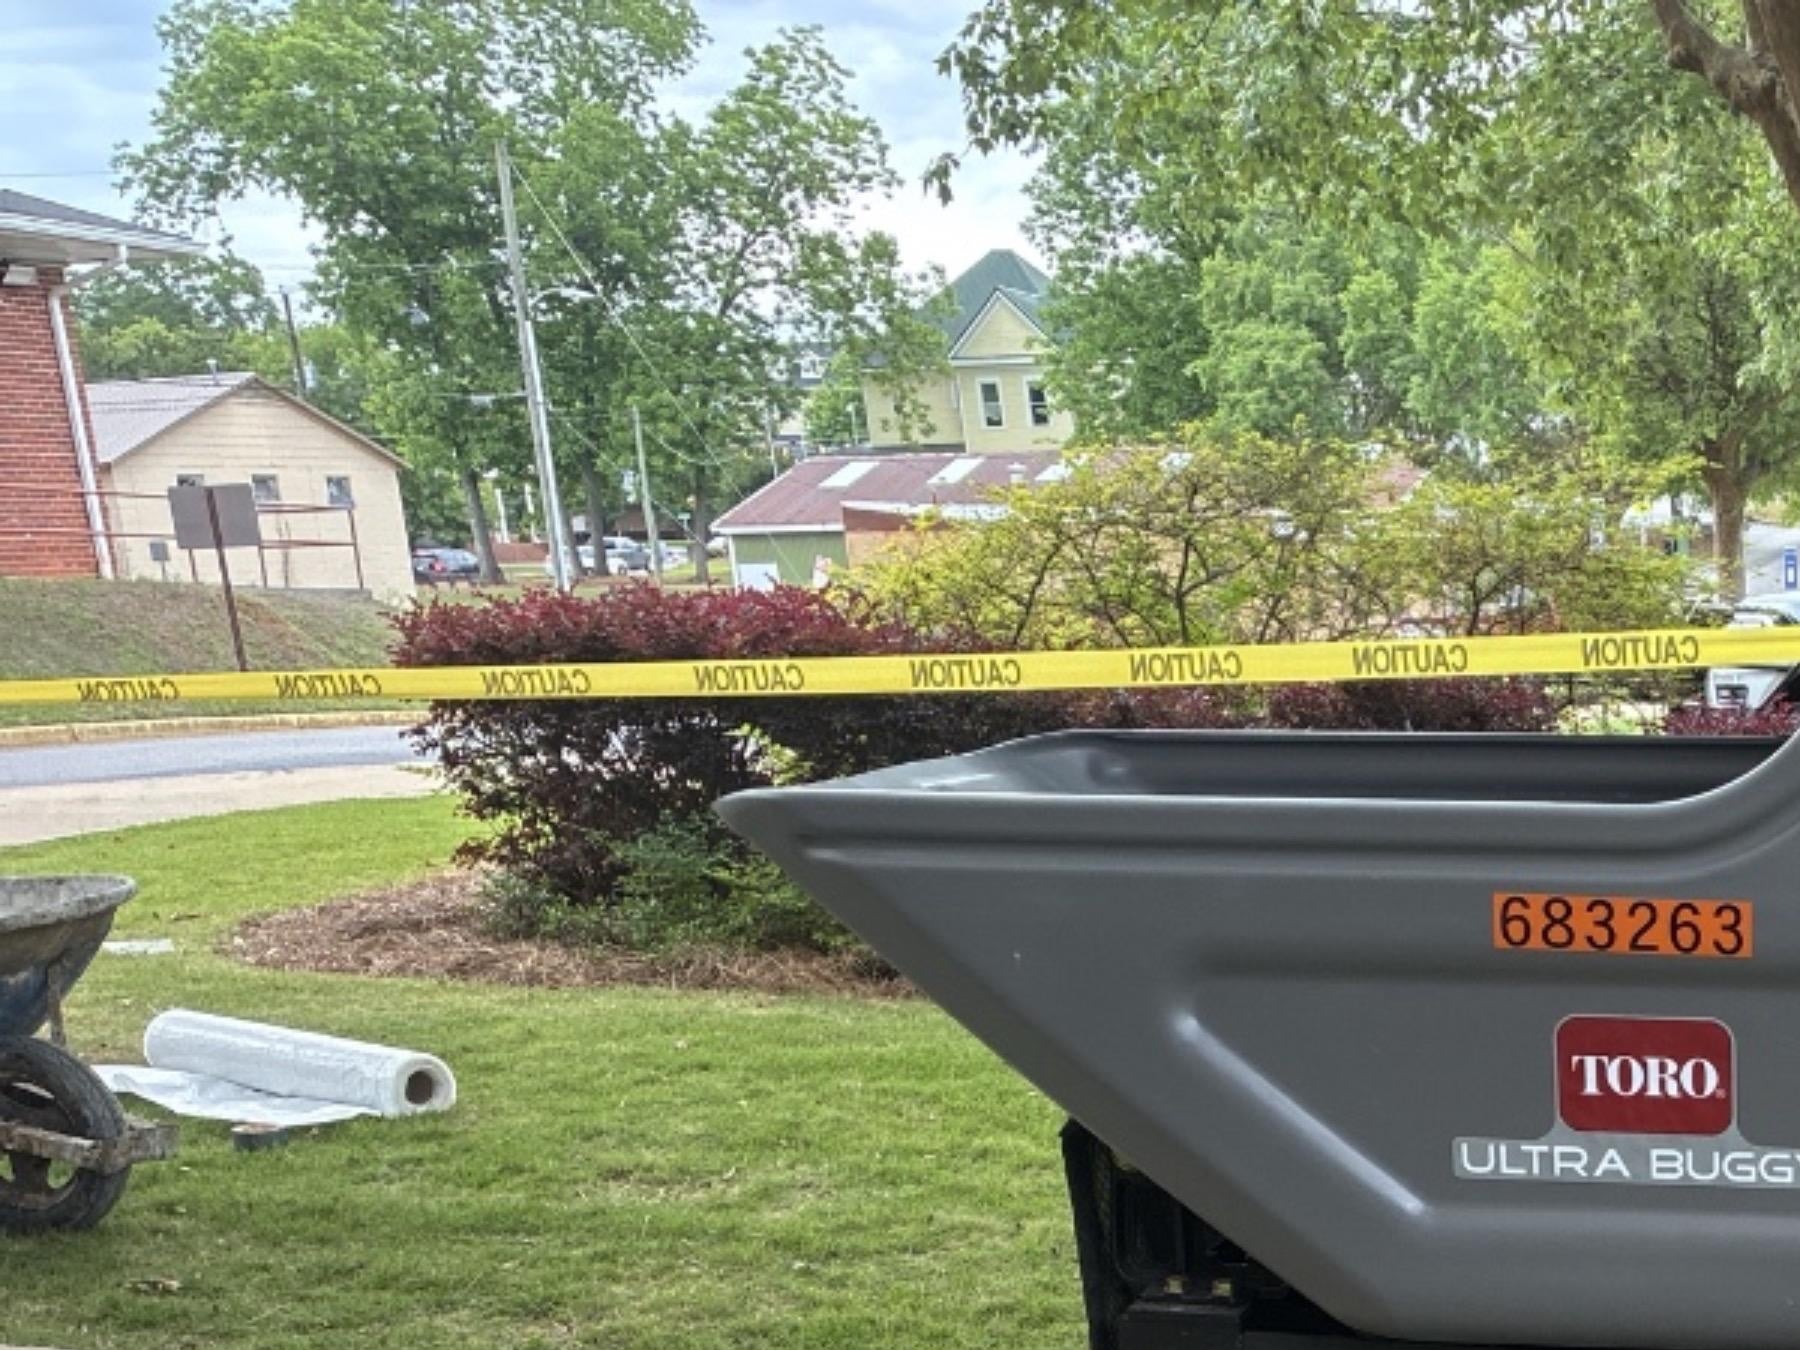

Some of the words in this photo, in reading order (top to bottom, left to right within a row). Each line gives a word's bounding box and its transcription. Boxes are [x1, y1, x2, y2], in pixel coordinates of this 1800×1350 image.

[1500, 896, 1744, 955] 683263
[1572, 1056, 1720, 1098] TORO
[1461, 1143, 1629, 1178] ULTRA
